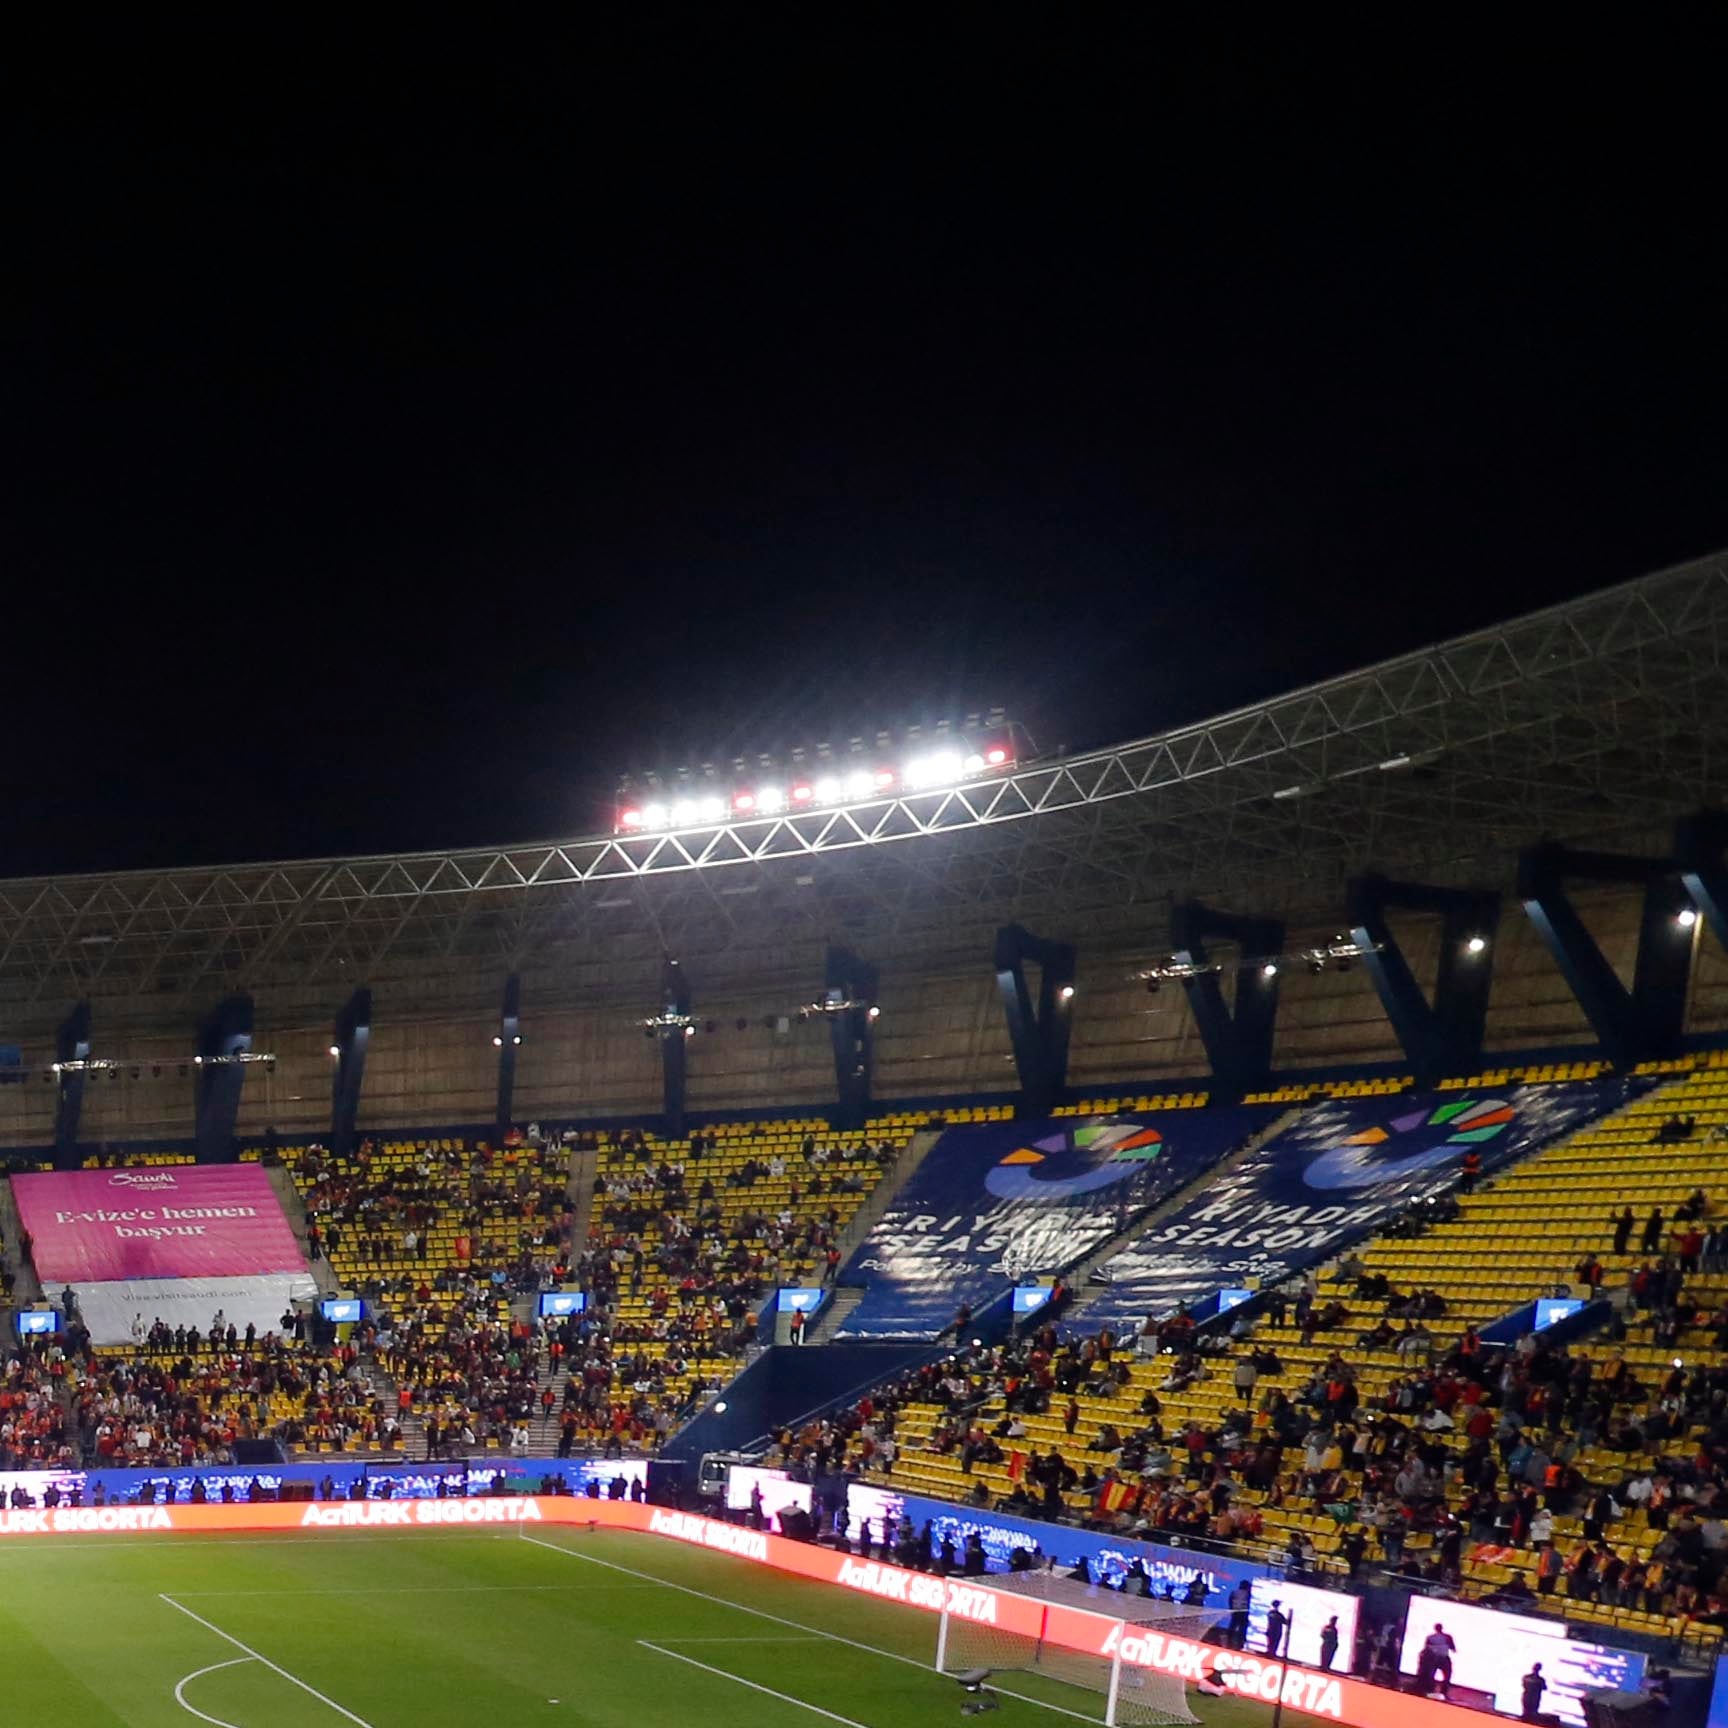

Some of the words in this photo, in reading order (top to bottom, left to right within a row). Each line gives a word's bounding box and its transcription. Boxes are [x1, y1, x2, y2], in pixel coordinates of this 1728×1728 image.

[161, 1205, 257, 1220] hemen
[1190, 1199, 1386, 1225] RIYADH
[115, 1224, 207, 1240] başvur
[1151, 1225, 1343, 1249] SEASON
